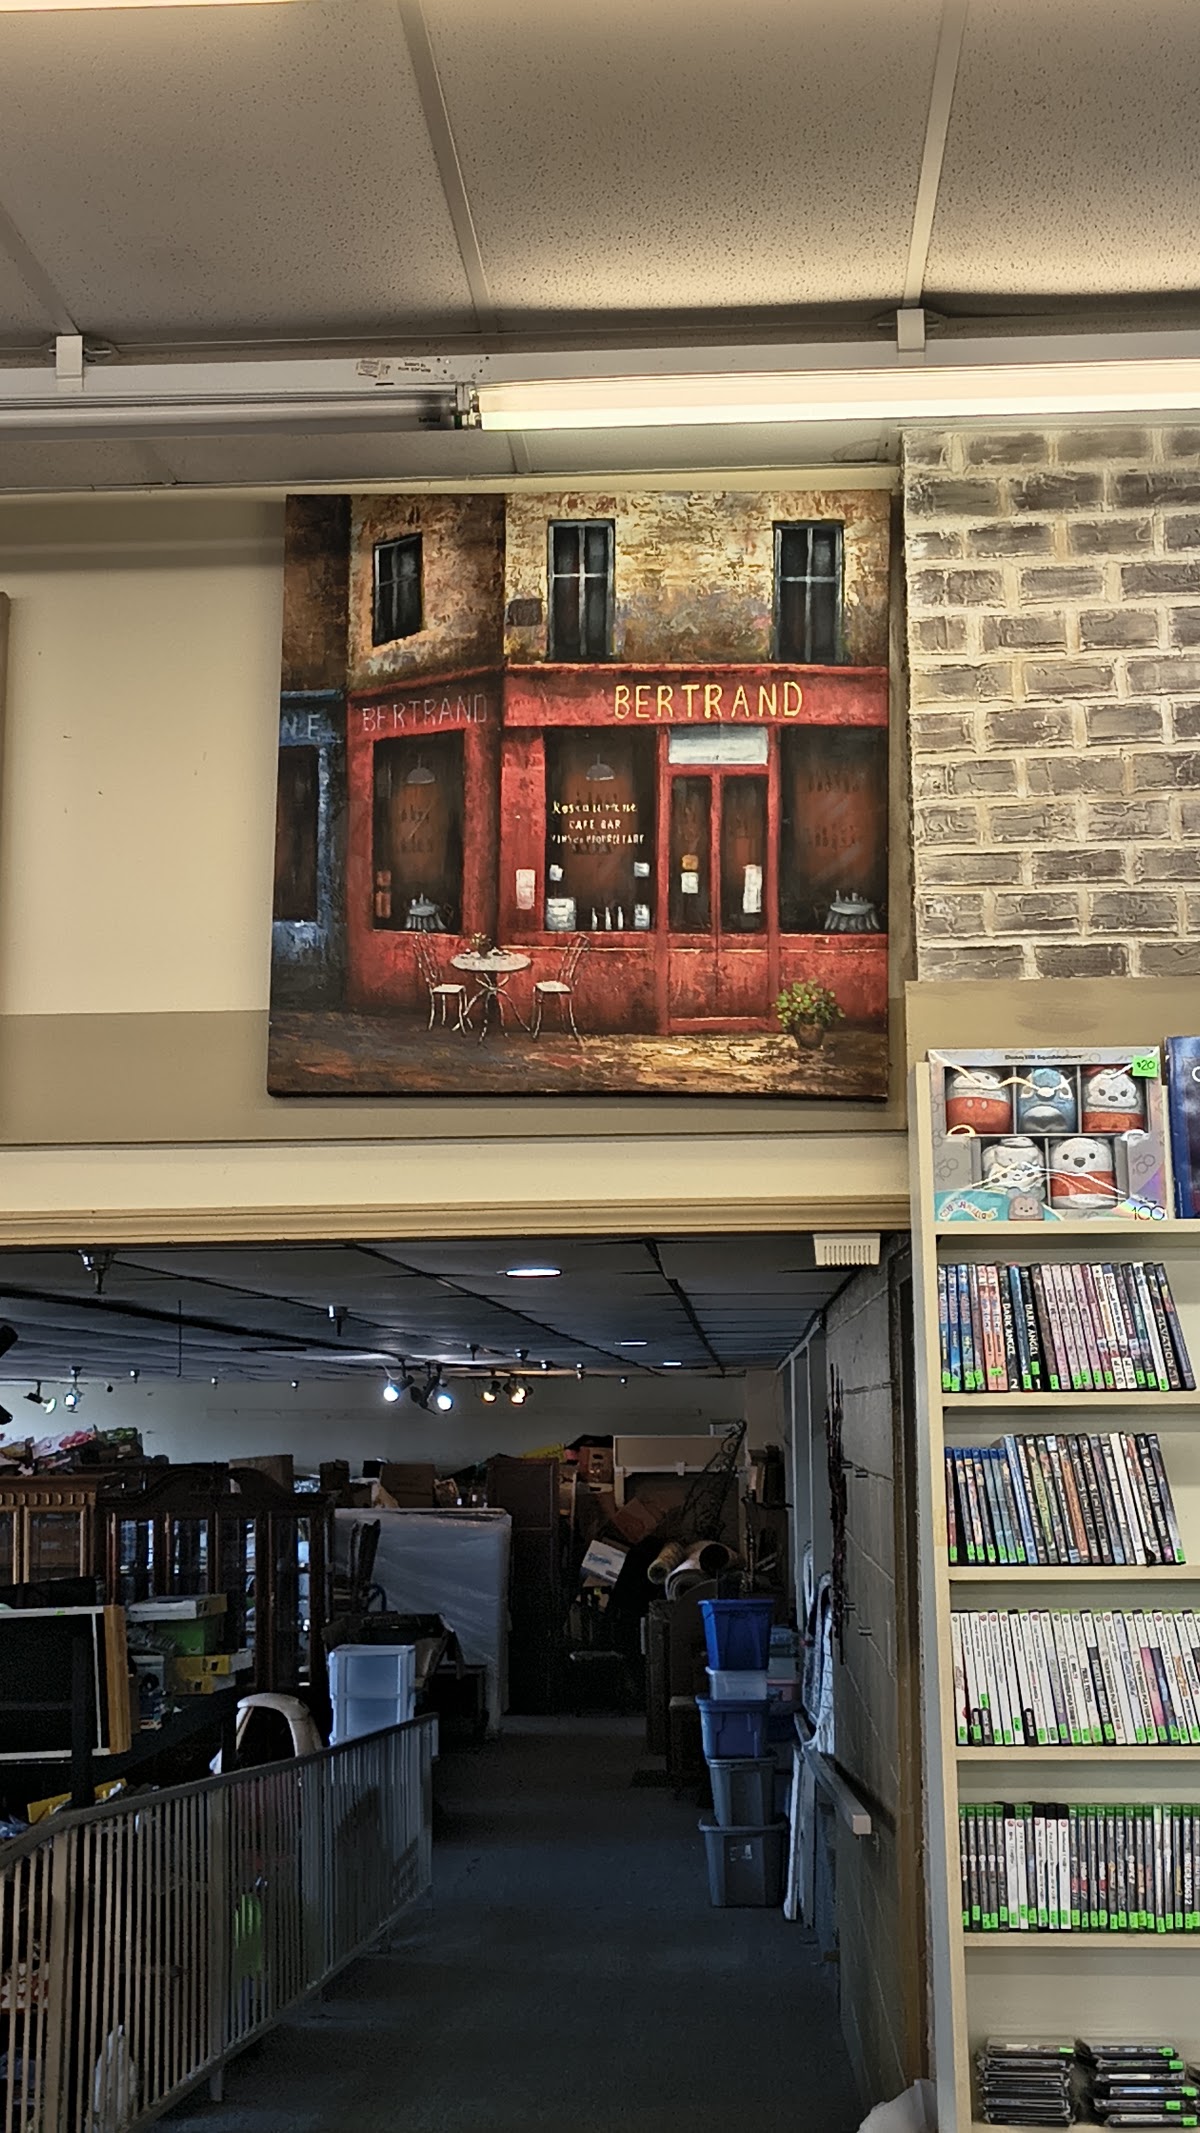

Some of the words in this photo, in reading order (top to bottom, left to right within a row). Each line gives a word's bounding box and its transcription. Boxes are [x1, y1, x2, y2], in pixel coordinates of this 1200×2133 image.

[361, 693, 488, 732] BERTRAND
[614, 681, 803, 719] BERTRAND
[1002, 1303, 1013, 1327] DARK
[1025, 1304, 1034, 1328] DARK
[1005, 1328, 1016, 1356] ANGEL
[1027, 1329, 1038, 1357] ANGEL
[1010, 1378, 1018, 1389] 2
